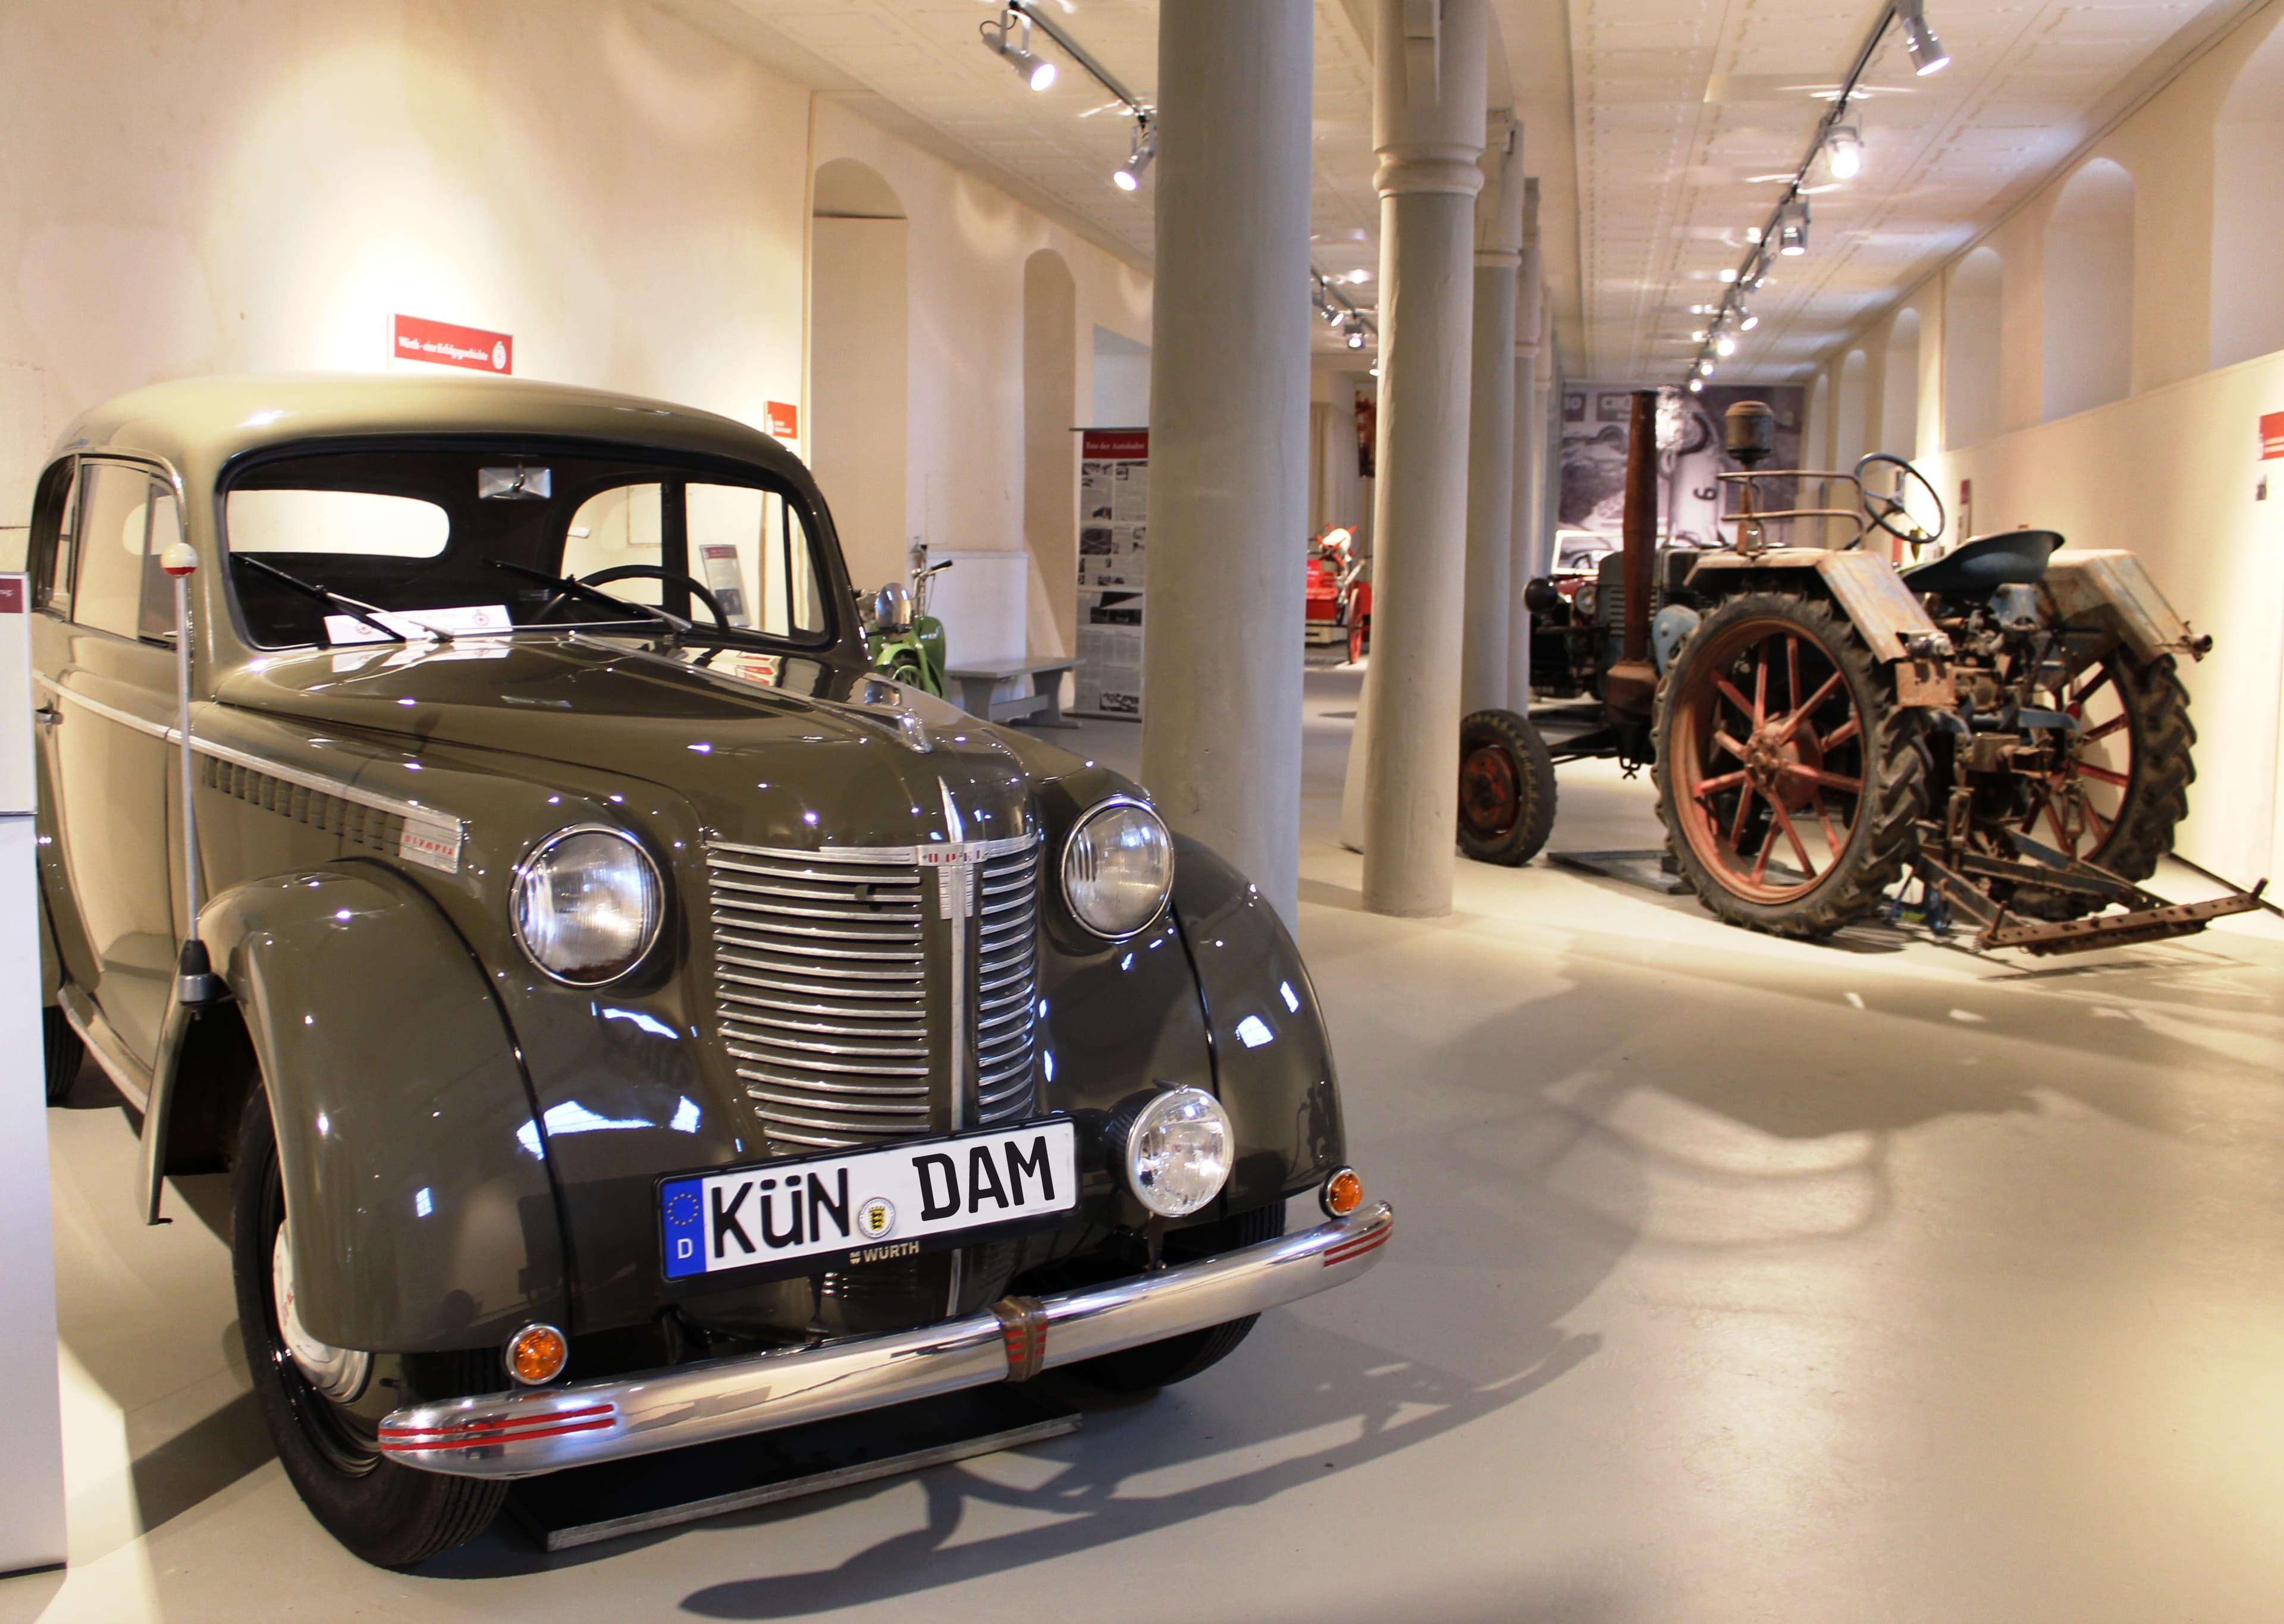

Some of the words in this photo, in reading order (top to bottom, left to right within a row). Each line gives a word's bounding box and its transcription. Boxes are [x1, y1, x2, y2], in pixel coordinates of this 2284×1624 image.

[912, 1136, 1055, 1221] DAM
[677, 1238, 693, 1259] D
[862, 1240, 920, 1262] WÜRTH
